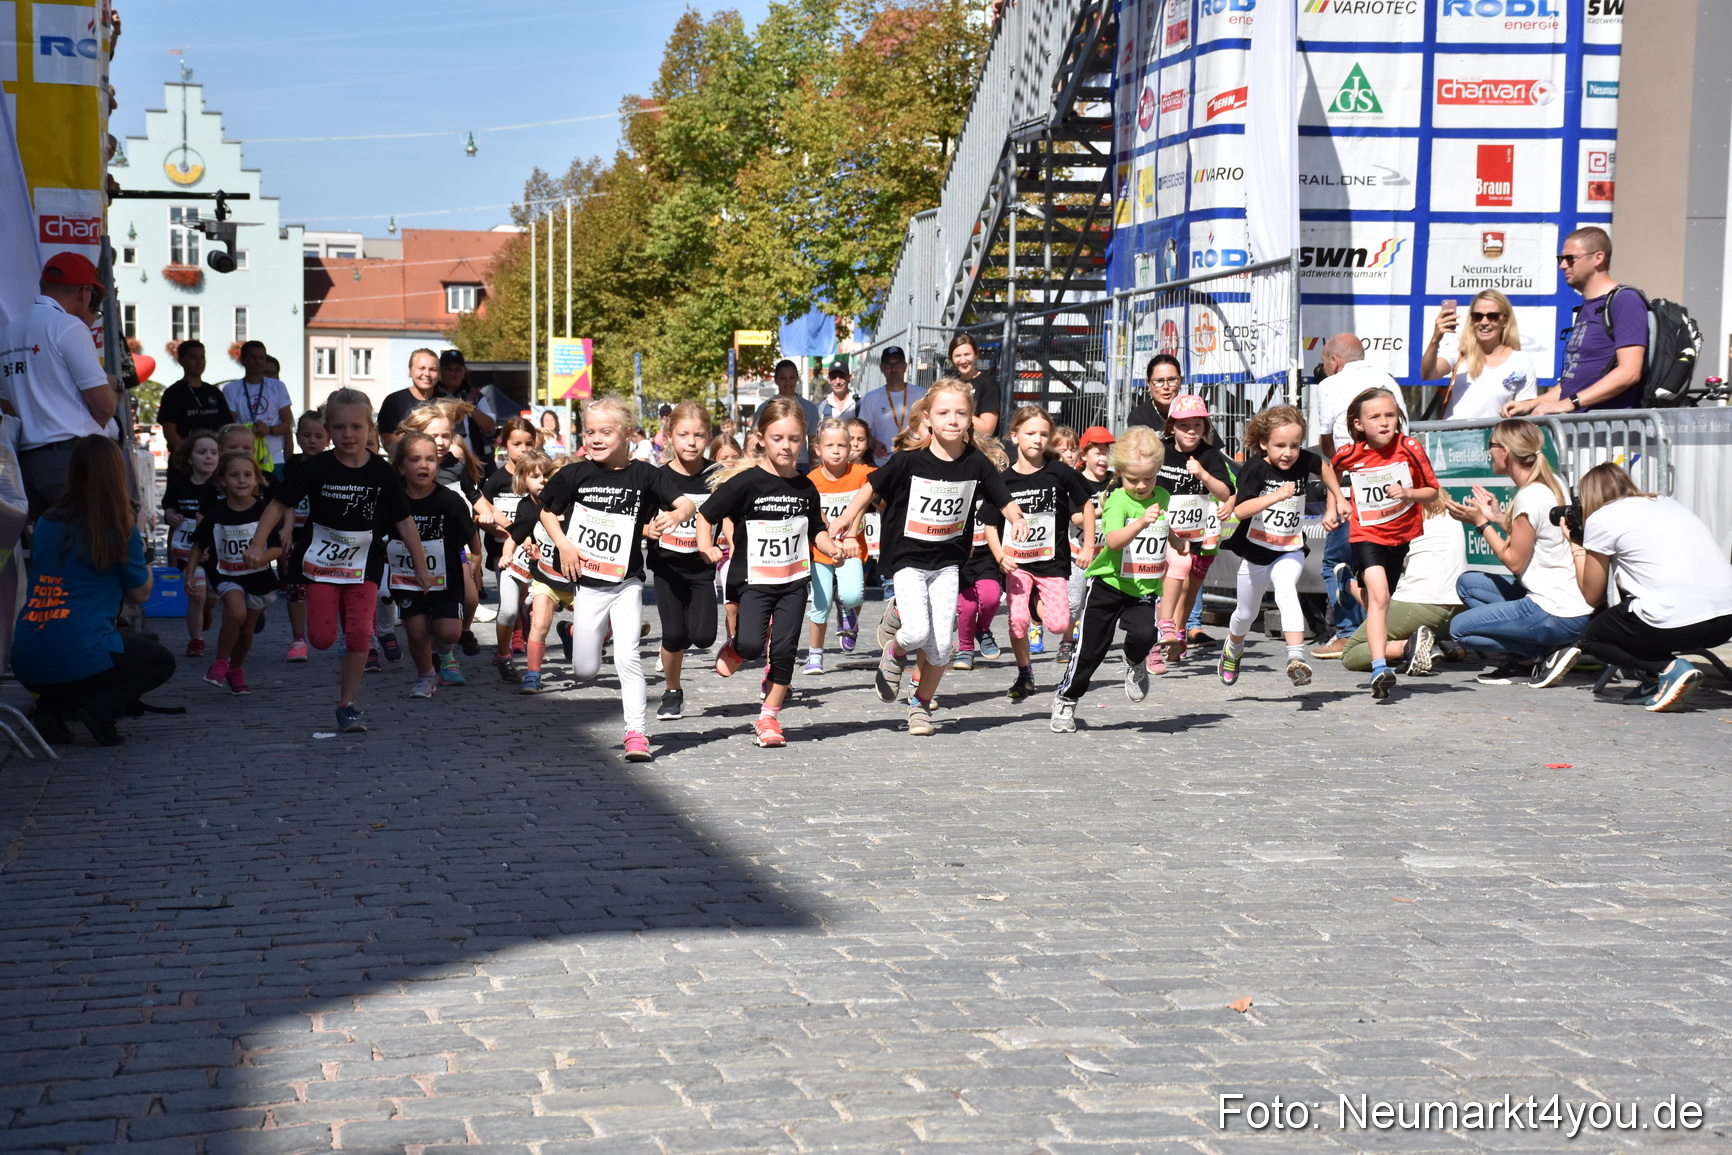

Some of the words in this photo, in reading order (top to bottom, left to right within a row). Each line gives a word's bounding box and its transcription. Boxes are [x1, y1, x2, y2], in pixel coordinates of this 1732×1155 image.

[1333, 0, 1417, 14] VARIOTEC
[1504, 15, 1559, 30] energie
[1440, 77, 1527, 99] charivari
[1214, 94, 1236, 112] DEHN
[1475, 179, 1511, 195] Braun
[1300, 246, 1368, 268] swn
[1300, 269, 1341, 279] adtwerke
[1343, 269, 1388, 279] neumarkt
[1462, 264, 1523, 275] Neumarkter
[1449, 275, 1533, 289] Lammsbräu
[1448, 447, 1492, 465] Event-Leit-Sys
[582, 495, 613, 505] adtlauf
[919, 496, 964, 516] 7432
[1168, 508, 1203, 525] 7349
[1264, 508, 1301, 528] 7535
[926, 526, 951, 534] Emma
[221, 537, 254, 556] 705
[578, 524, 622, 554] 7360
[757, 533, 801, 557] 7517
[316, 539, 361, 561] 7347
[1013, 550, 1040, 558] Patricia
[395, 554, 437, 571] 700
[584, 560, 601, 572] Leni
[313, 566, 351, 578] Franziska
[33, 585, 70, 597] FOTO-
[28, 597, 66, 609] TEAM-
